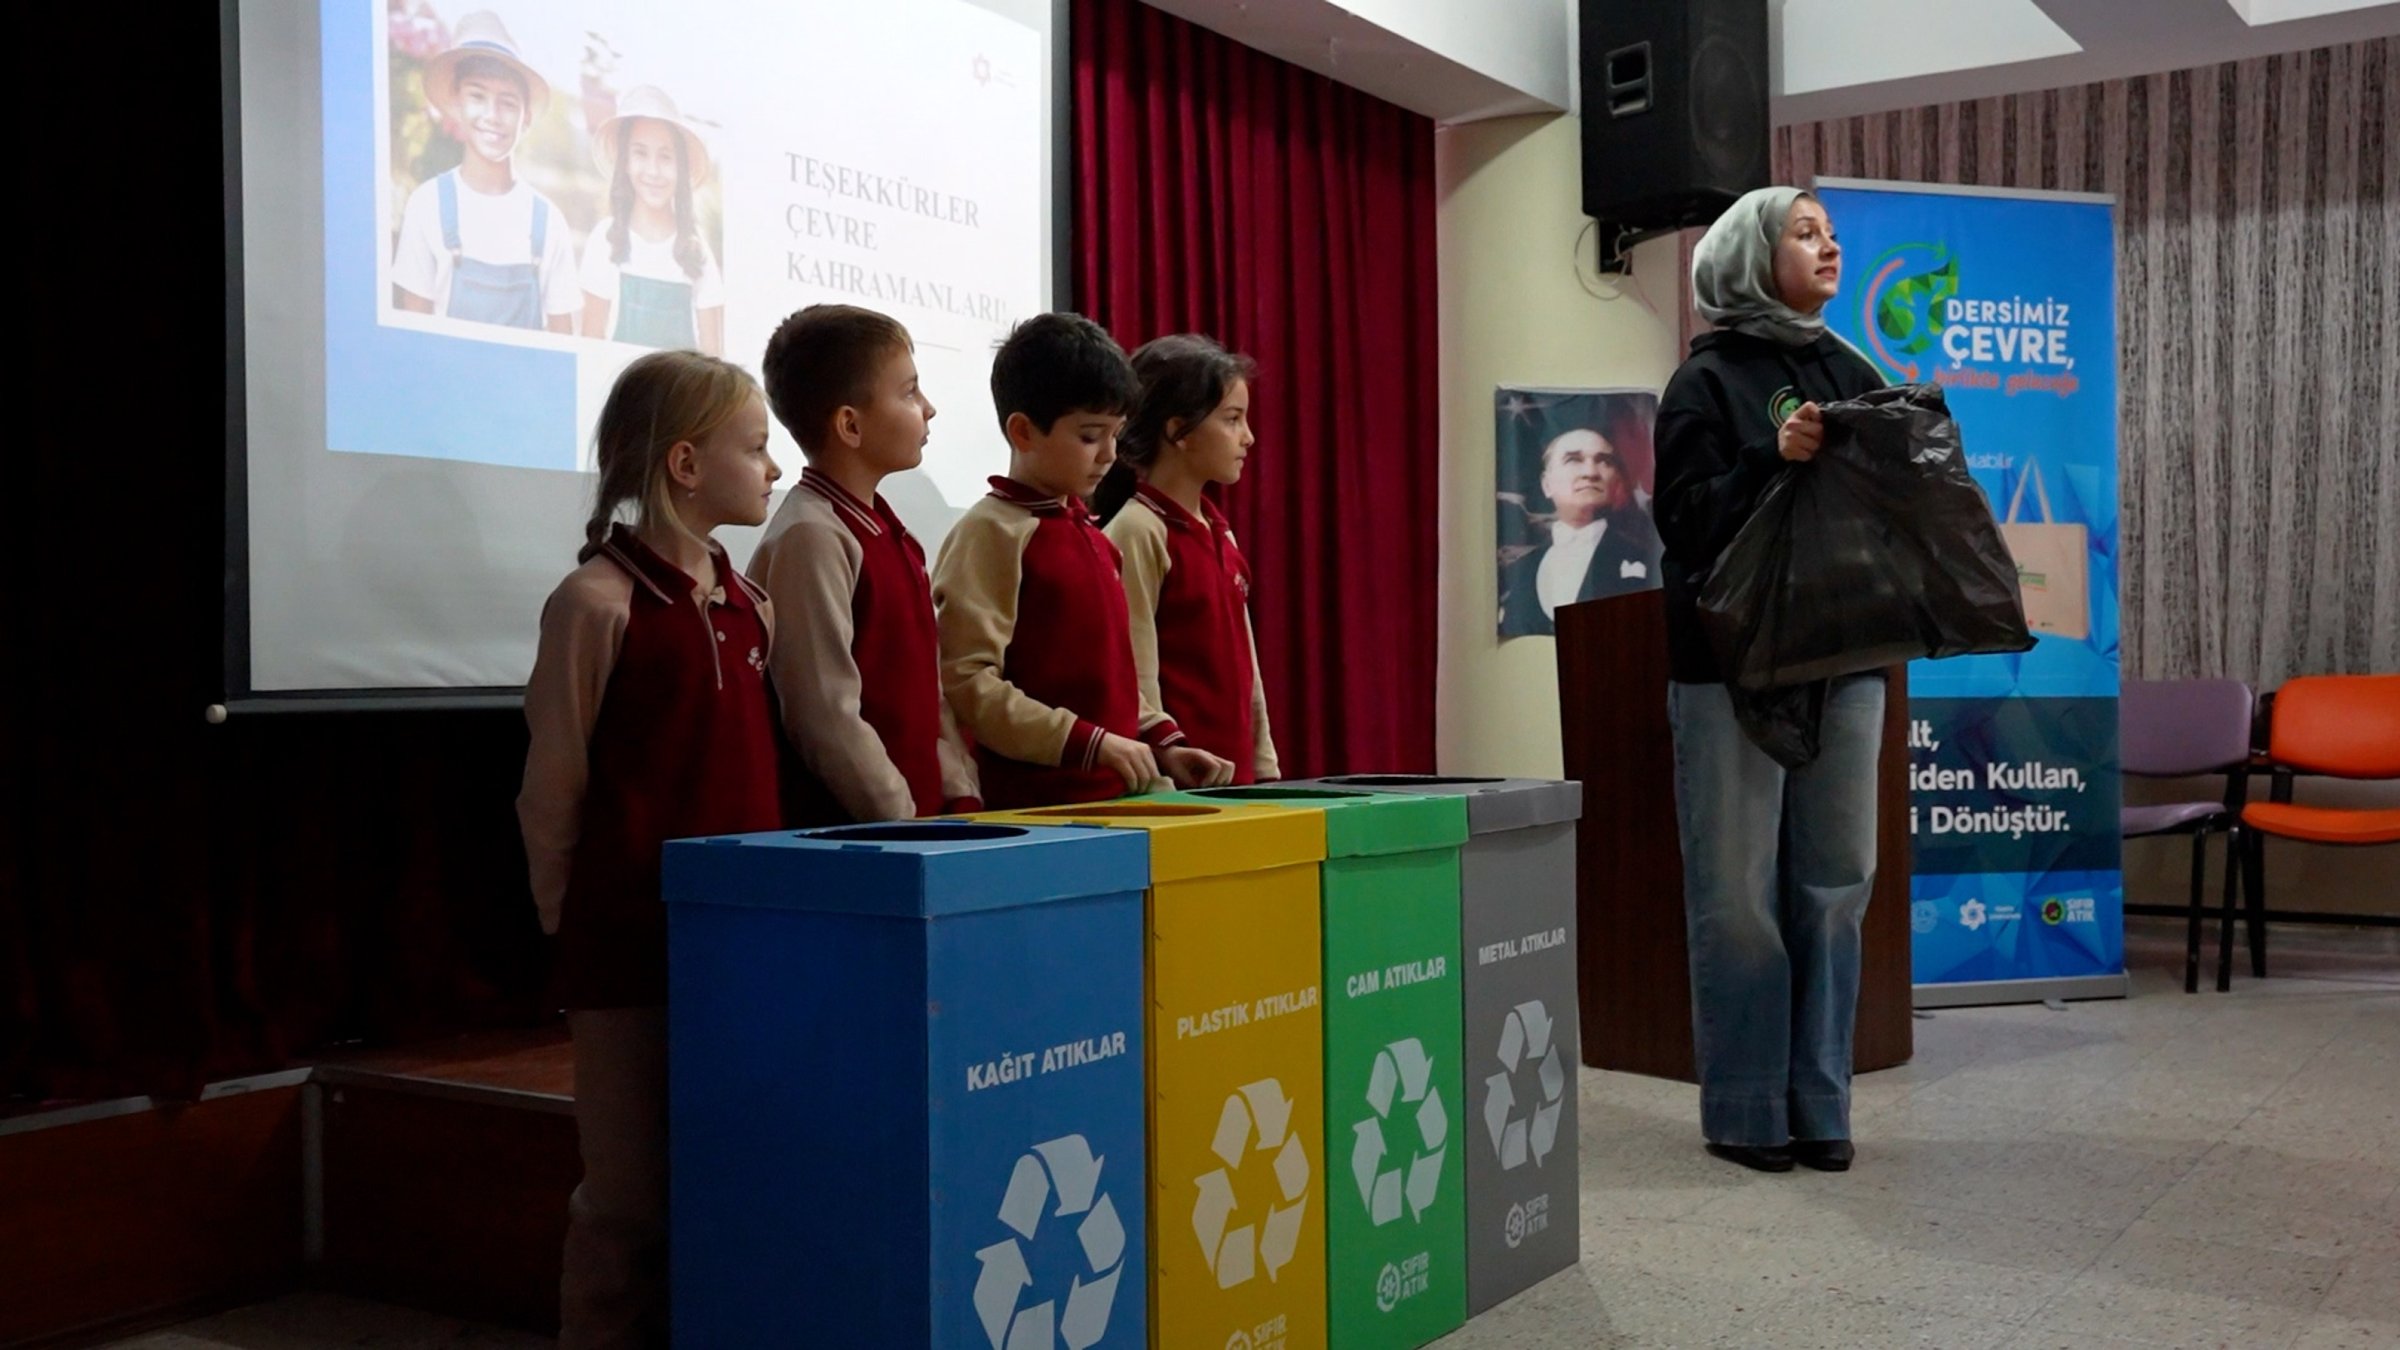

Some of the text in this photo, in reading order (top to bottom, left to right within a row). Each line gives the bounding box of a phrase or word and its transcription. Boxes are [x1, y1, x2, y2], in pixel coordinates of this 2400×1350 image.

[784, 151, 980, 229] TEŞEKKÜRLER
[786, 203, 878, 252] ÇEVRE
[787, 251, 1008, 327] KAHRAMANLARI!
[1947, 296, 2070, 326] DERSİMİZ
[1942, 325, 2074, 370] ÇEVRE,
[1909, 762, 2086, 792] iden Kullan,
[1931, 805, 2070, 840] Dönüştür.
[1478, 927, 1566, 966] METAL ATIKLAR
[1346, 956, 1447, 998] CAM ATIKLAR
[1177, 986, 1318, 1040] PLASTİK ATIKLAR
[967, 1031, 1126, 1091] KAĞIT ATIKLAR
[1402, 1272, 1429, 1299] ATIK
